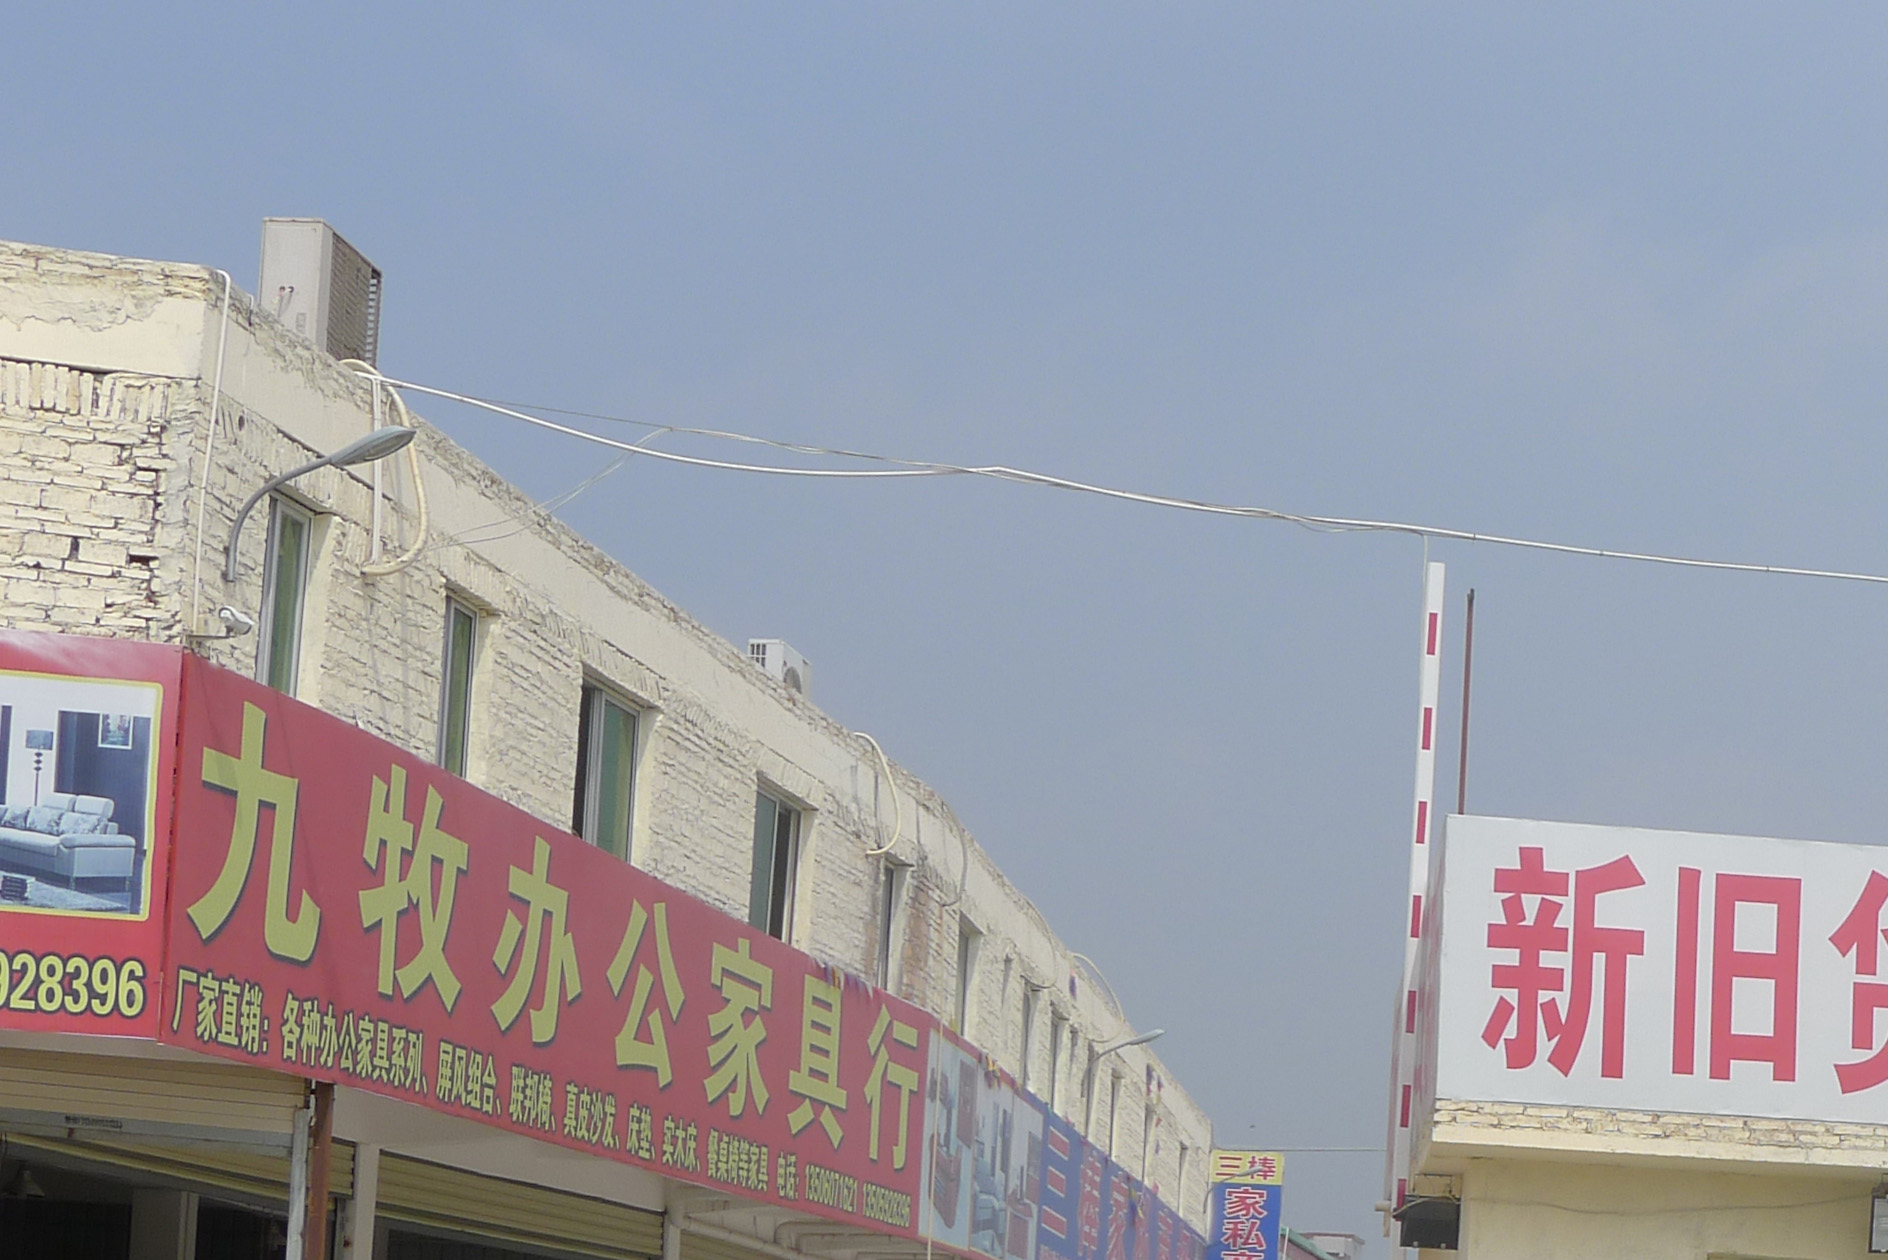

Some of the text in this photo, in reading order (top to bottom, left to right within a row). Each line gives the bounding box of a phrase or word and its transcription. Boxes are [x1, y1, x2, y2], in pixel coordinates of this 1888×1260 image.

[187, 701, 920, 1169] 九牧办公家具行
[1215, 1155, 1277, 1180] 三棒
